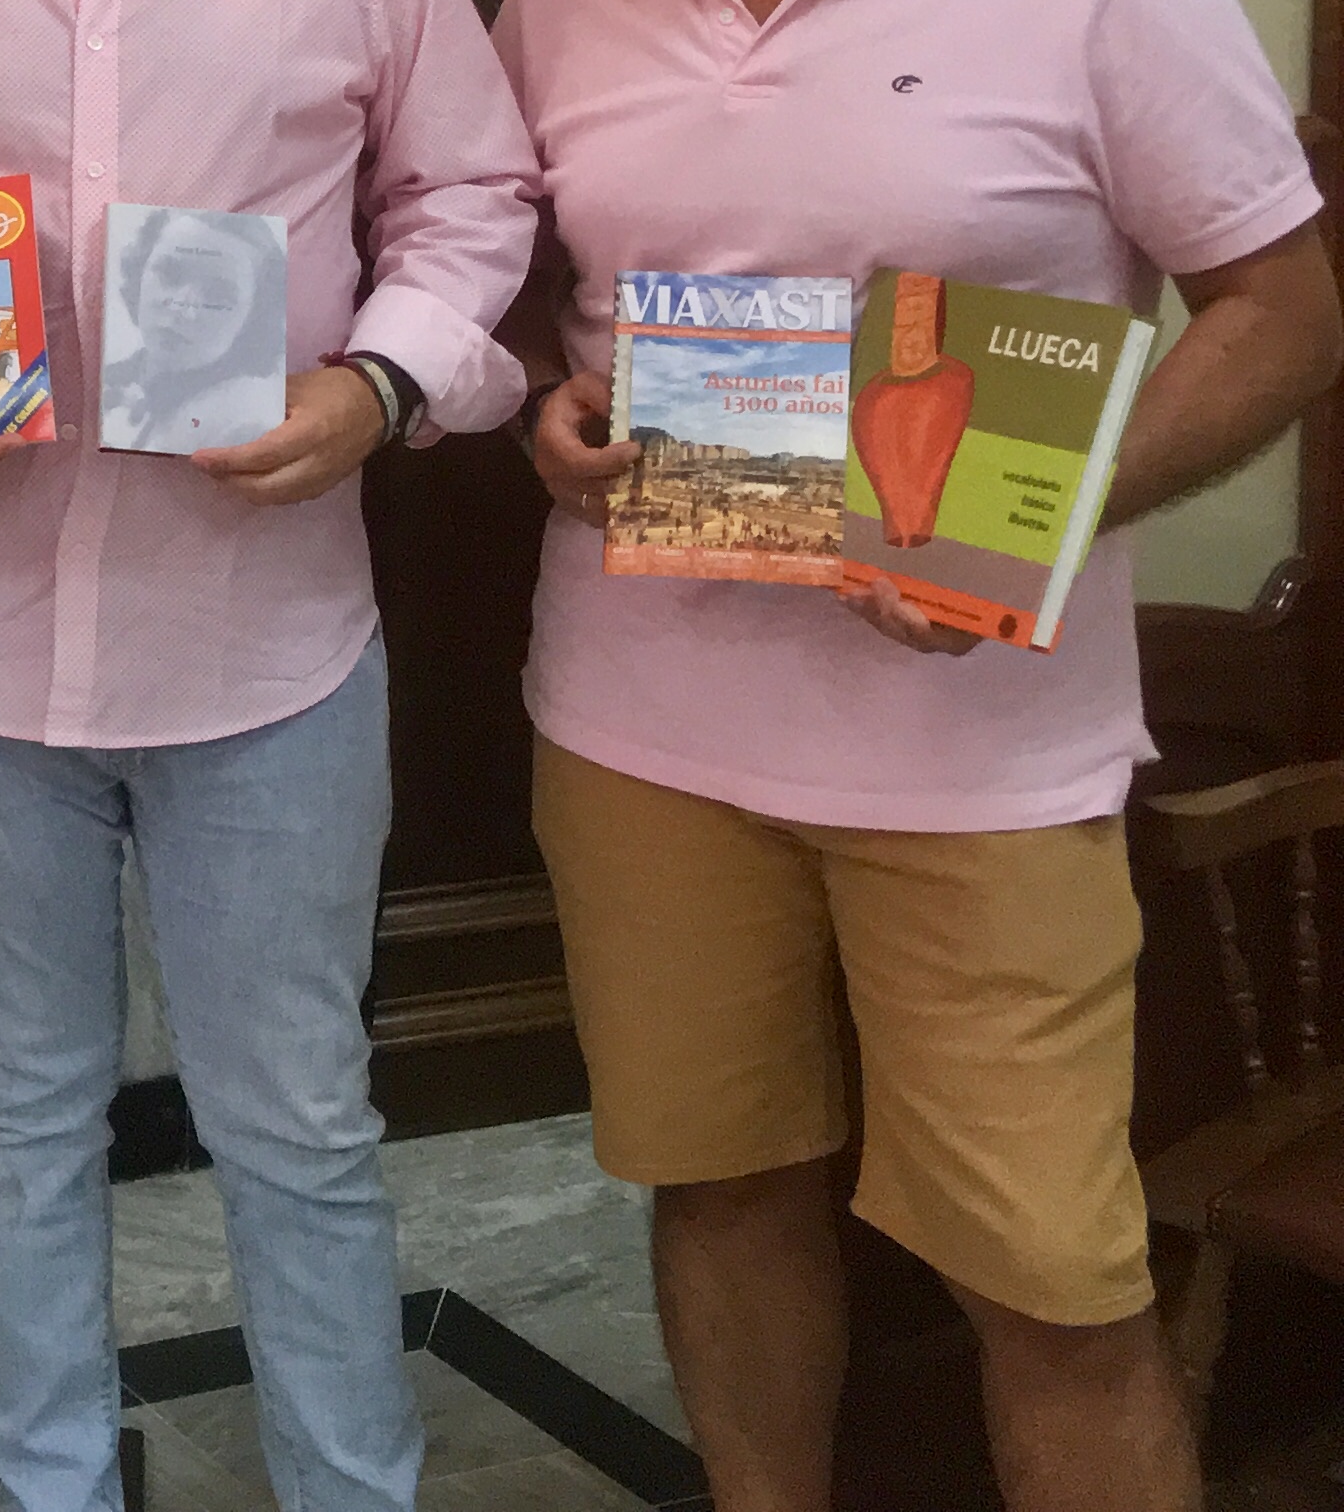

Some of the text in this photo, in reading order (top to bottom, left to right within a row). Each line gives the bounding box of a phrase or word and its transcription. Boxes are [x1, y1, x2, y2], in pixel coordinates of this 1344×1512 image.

[621, 283, 849, 332] VIAXAST
[988, 326, 1100, 373] LLUECA
[704, 371, 844, 394] Asturies fai
[723, 394, 844, 415] 1300 años
